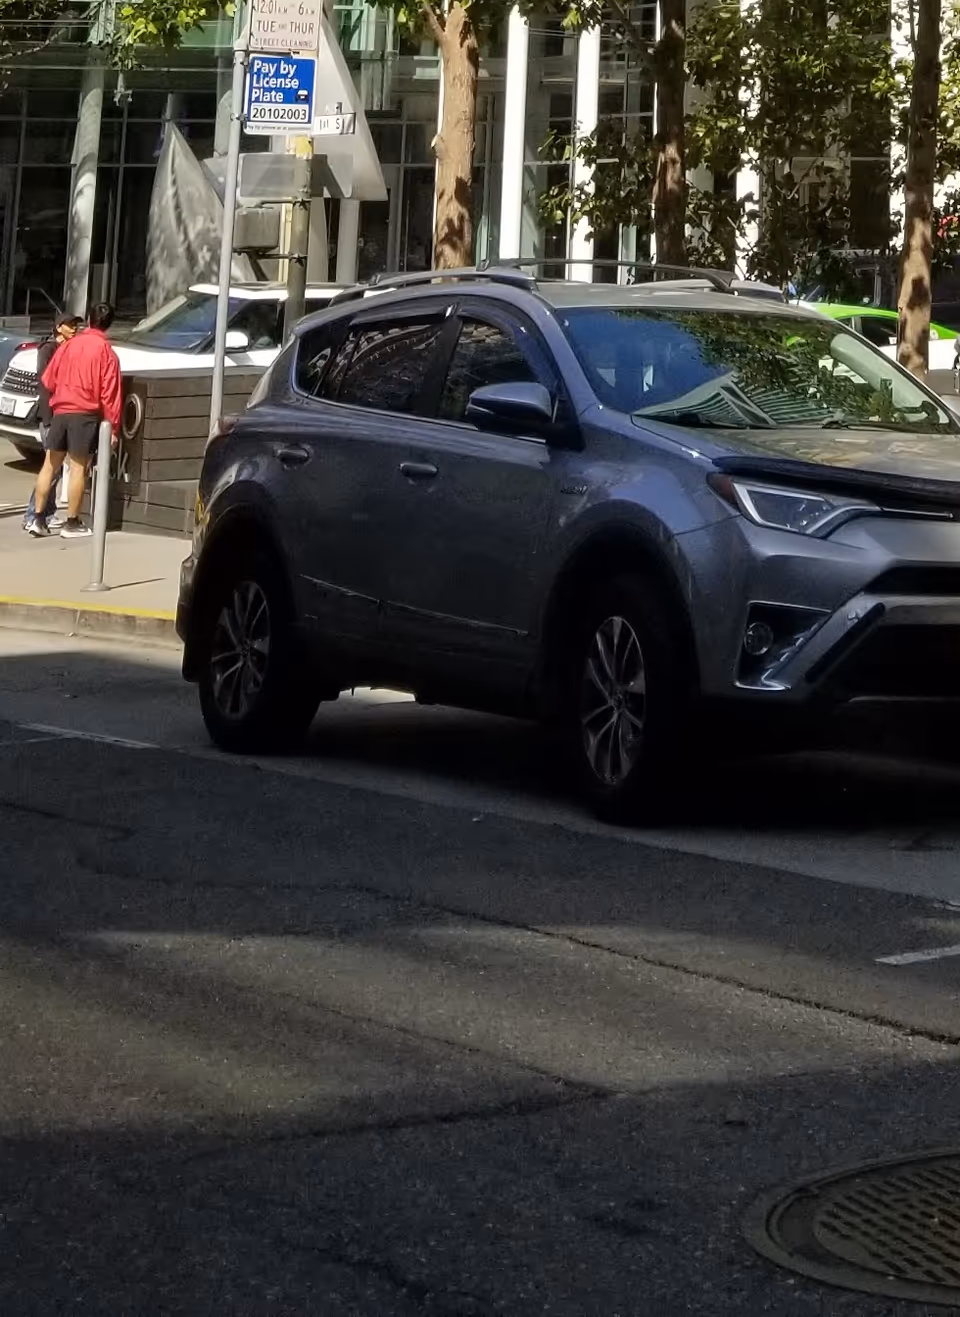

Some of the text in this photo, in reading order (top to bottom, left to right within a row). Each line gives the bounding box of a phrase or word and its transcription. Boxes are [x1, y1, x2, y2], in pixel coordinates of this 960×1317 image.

[257, 20, 276, 32] TUE
[290, 22, 315, 34] THUR
[255, 38, 313, 47] STREET CLEANING
[253, 60, 297, 77] Pay by
[252, 74, 299, 88] License
[251, 88, 284, 102] Plate
[252, 108, 307, 120] 20102003
